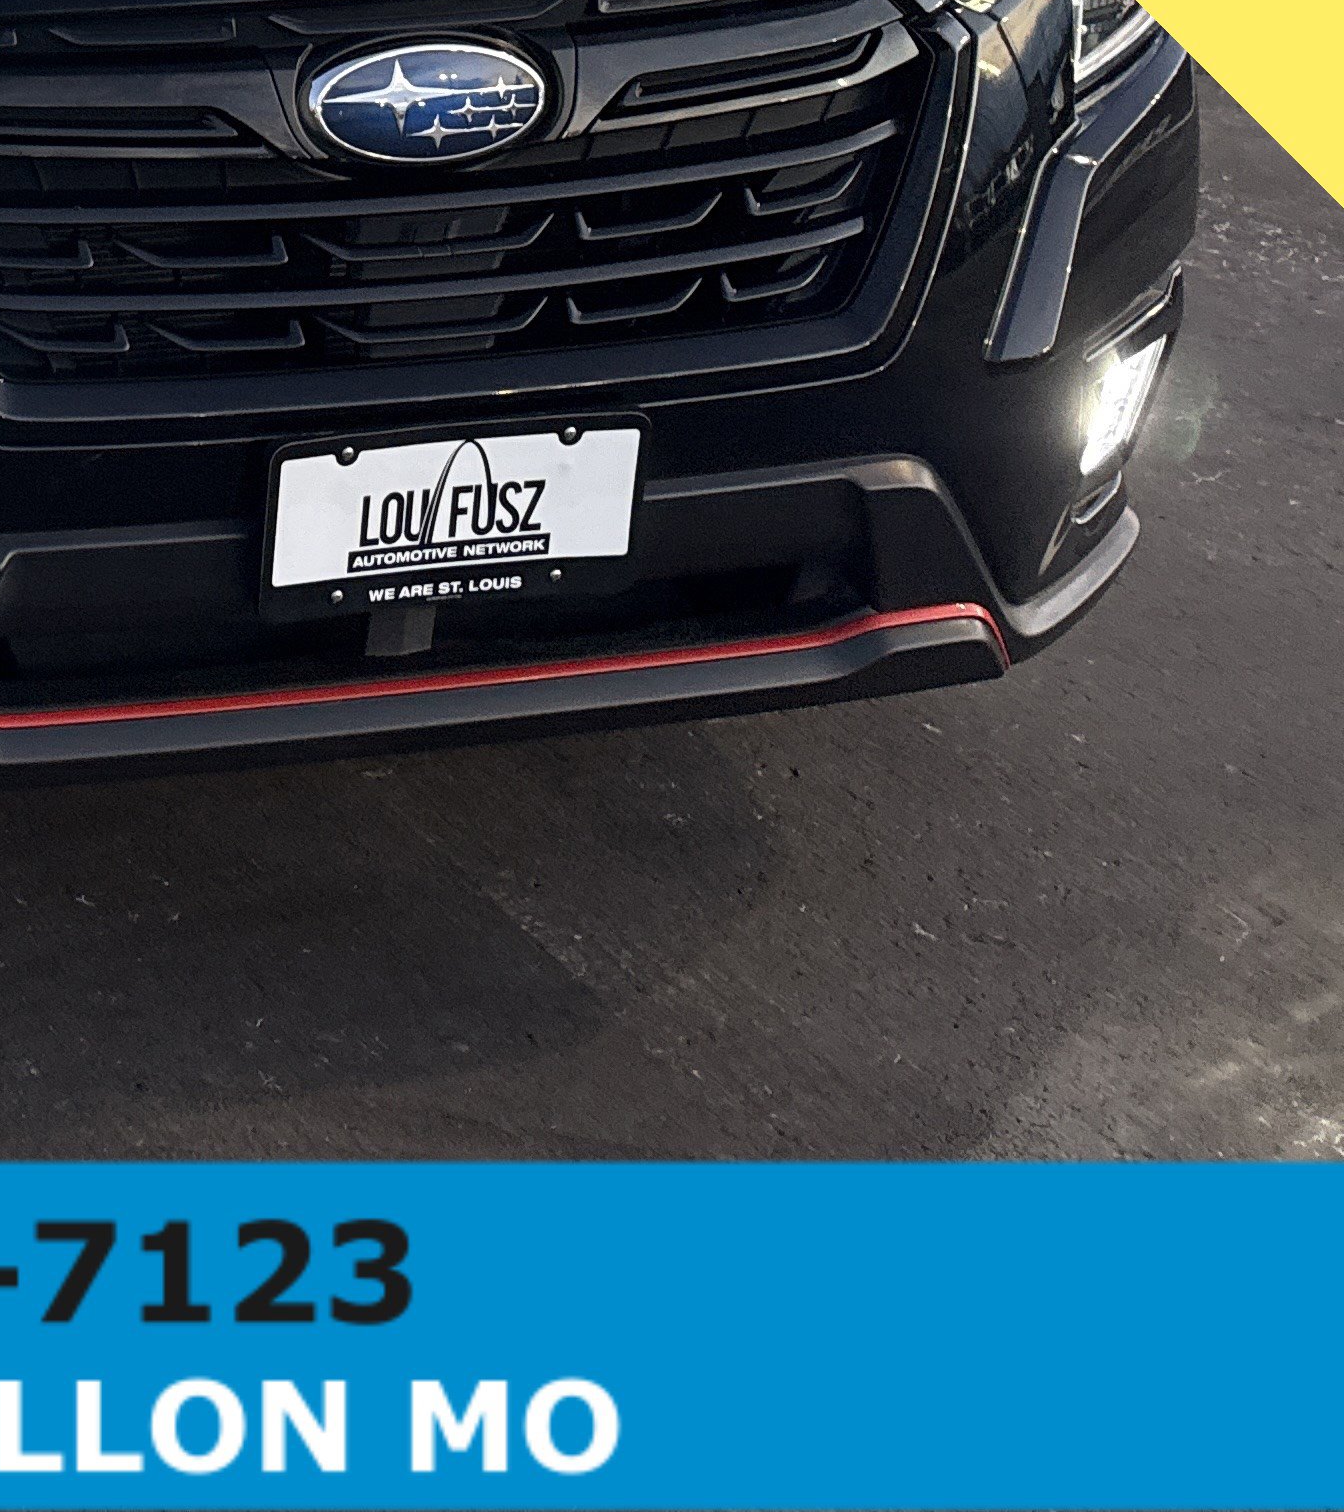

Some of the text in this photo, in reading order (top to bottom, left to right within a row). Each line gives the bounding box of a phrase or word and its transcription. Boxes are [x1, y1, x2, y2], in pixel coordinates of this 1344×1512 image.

[359, 479, 547, 547] LOU FUSZ
[352, 538, 546, 569] AUTOMOTIVE NETWORK
[368, 588, 395, 602] WE
[398, 584, 434, 599] ARE
[438, 580, 463, 596] ST.
[468, 575, 523, 593] LOUIS
